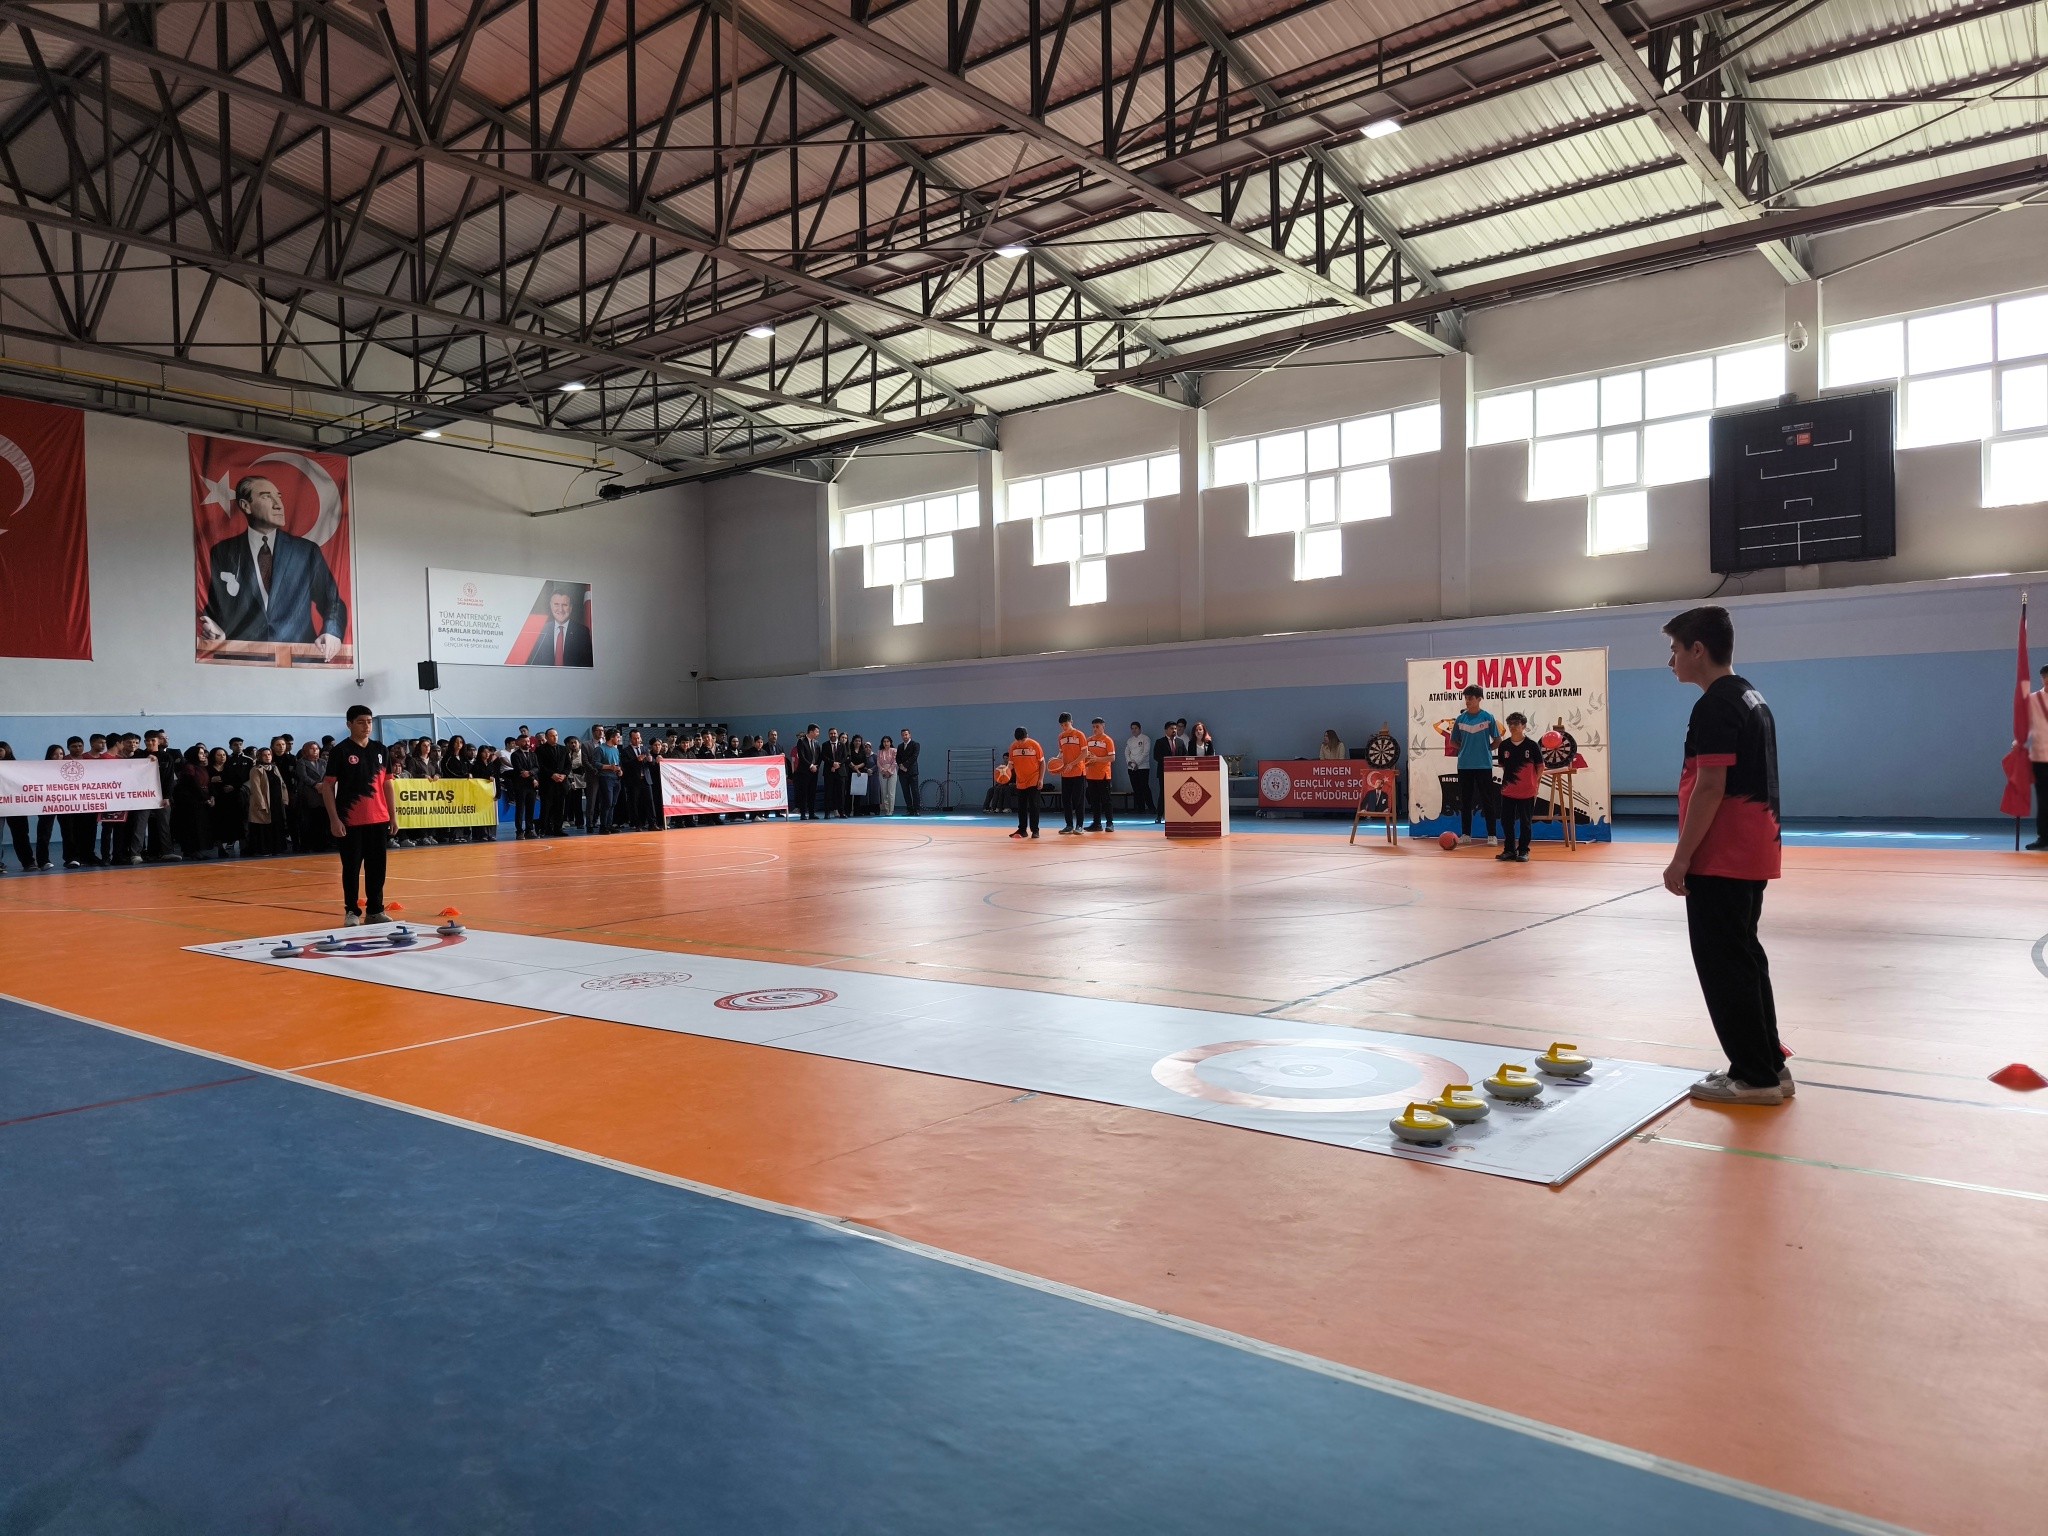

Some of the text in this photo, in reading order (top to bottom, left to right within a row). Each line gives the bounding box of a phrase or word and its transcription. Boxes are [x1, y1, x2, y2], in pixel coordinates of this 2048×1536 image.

[456, 612, 492, 620] ANTRENÖR
[441, 619, 500, 628] SPORCULARIMIZA
[1442, 654, 1562, 690] 19 MAYIS
[1429, 690, 1463, 701] ATATÜRK'Ü
[1486, 688, 1515, 701] GENÇLİK
[1517, 690, 1526, 699] VE
[1528, 689, 1547, 698] SPOR
[1549, 688, 1582, 698] BAYRAMI
[1524, 750, 1530, 758] 6
[1313, 767, 1351, 776] MENGEN
[46, 783, 80, 791] MENGEN
[82, 781, 122, 790] PAZARKÖY
[1294, 778, 1332, 789] GENÇLİK
[1347, 779, 1362, 787] SPO
[16, 794, 43, 803] BİLGİN
[46, 793, 77, 803] AŞÇILIK
[80, 790, 113, 800] MESLEKİ
[127, 790, 156, 798] TEKNİK
[400, 790, 455, 804] GENTAŞ
[671, 794, 705, 804] ANADOLU
[736, 790, 757, 802] HATİP
[760, 788, 781, 800] LİSESİ
[1293, 790, 1361, 801] İLÇE MÜDÜRLÜ
[42, 803, 107, 813] ANADOLU LİSESİ
[429, 806, 456, 814] ANADOLU
[458, 804, 476, 814] LİSESİ
